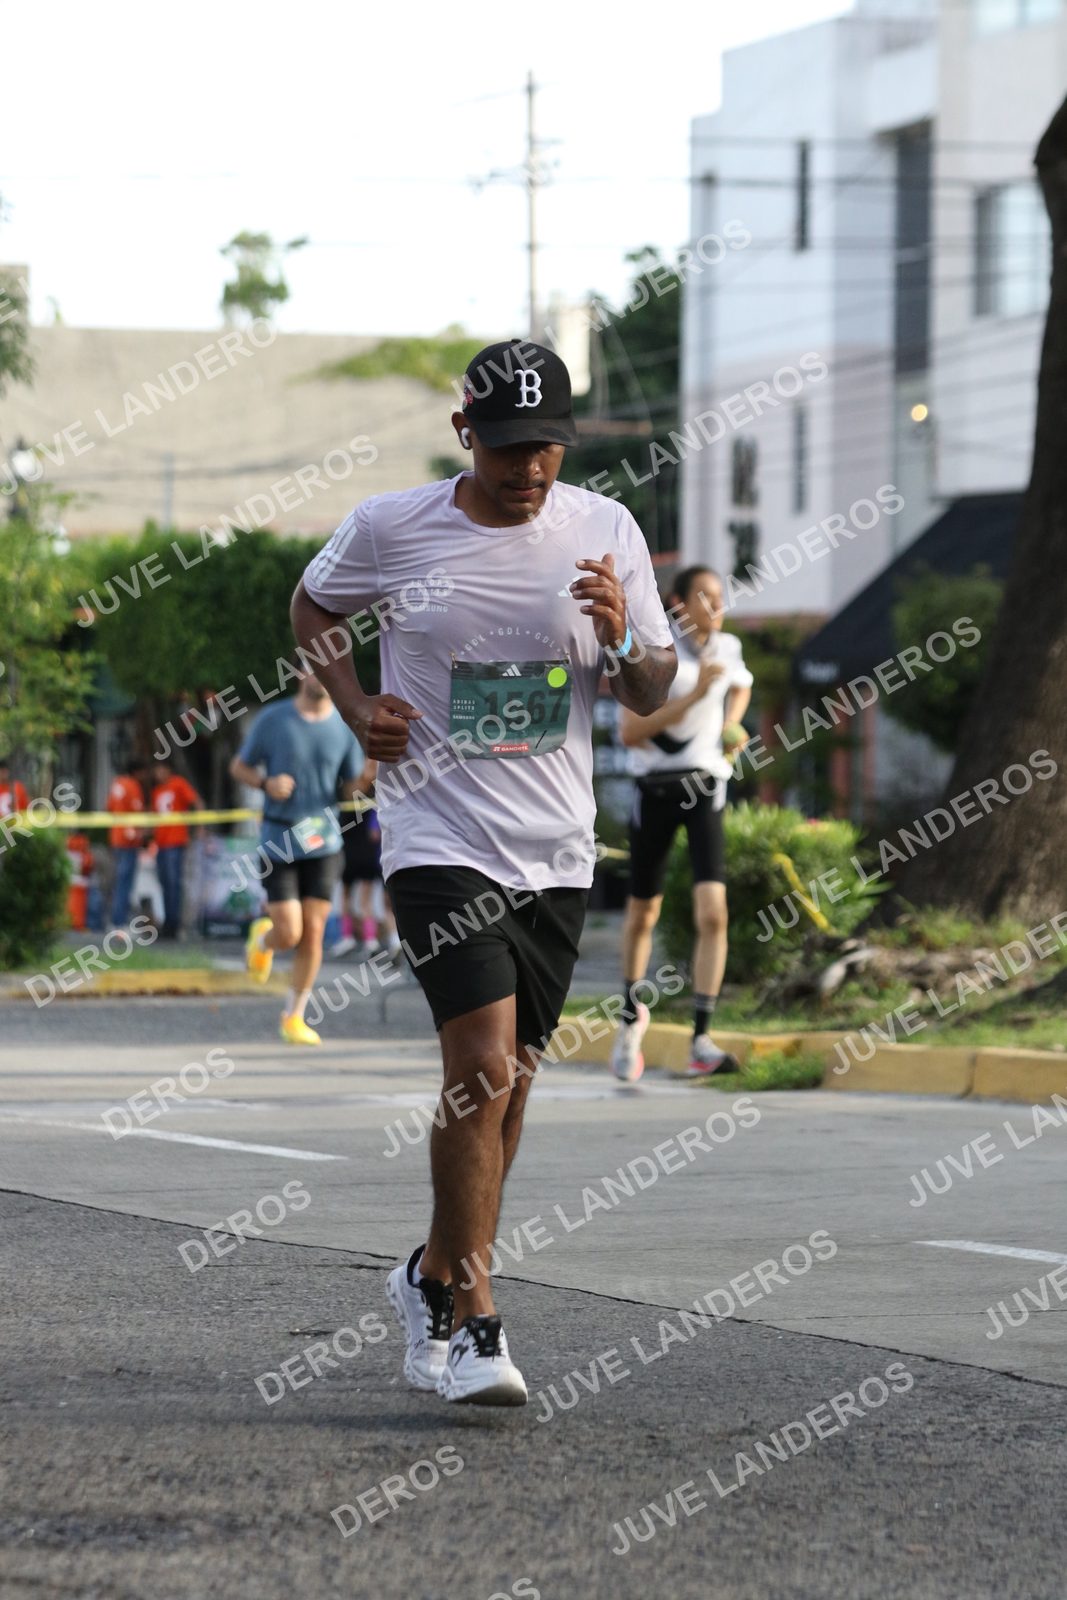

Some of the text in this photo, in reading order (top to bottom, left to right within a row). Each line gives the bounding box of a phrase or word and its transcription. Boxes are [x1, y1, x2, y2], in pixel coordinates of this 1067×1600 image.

[514, 369, 543, 408] B
[464, 627, 555, 651] GDL GDL GDL
[484, 690, 566, 726] 1567
